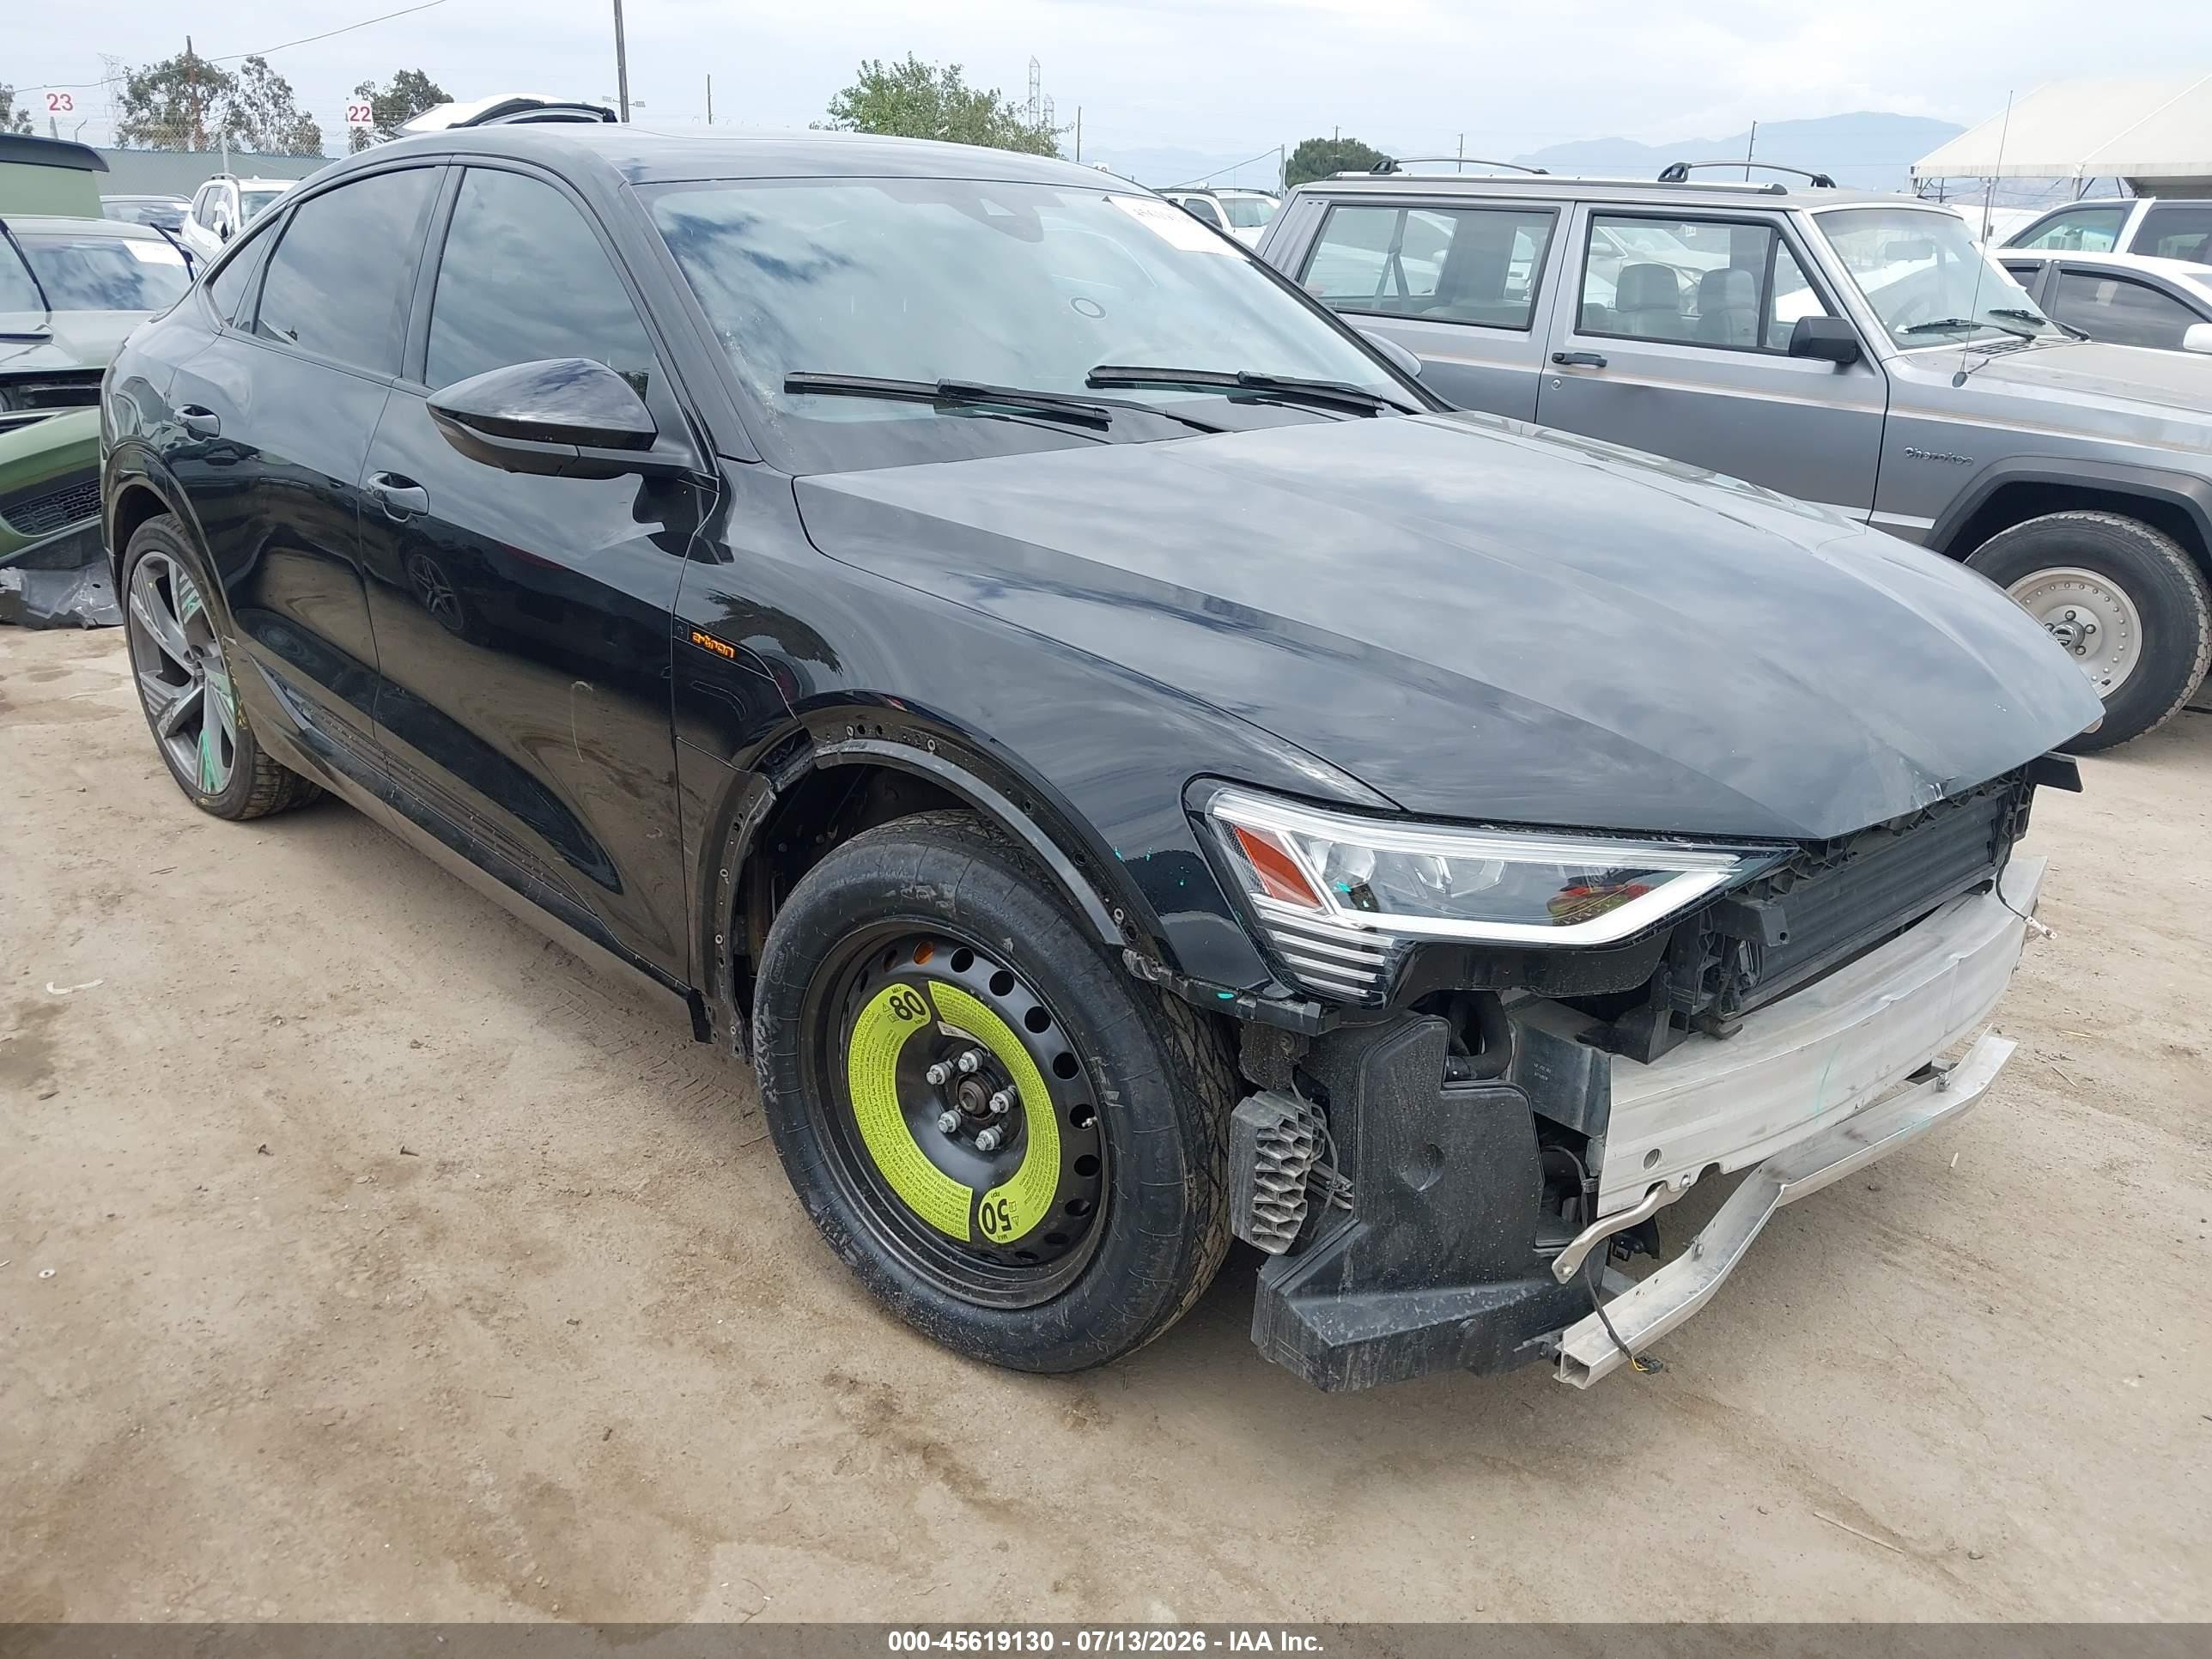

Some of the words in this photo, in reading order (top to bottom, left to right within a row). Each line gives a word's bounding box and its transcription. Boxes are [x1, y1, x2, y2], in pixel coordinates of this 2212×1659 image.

[46, 93, 74, 111] 23
[348, 106, 372, 122] 22
[1905, 447, 1973, 465] Cherokee
[889, 990, 927, 1021] 80
[981, 1198, 1012, 1235] 50
